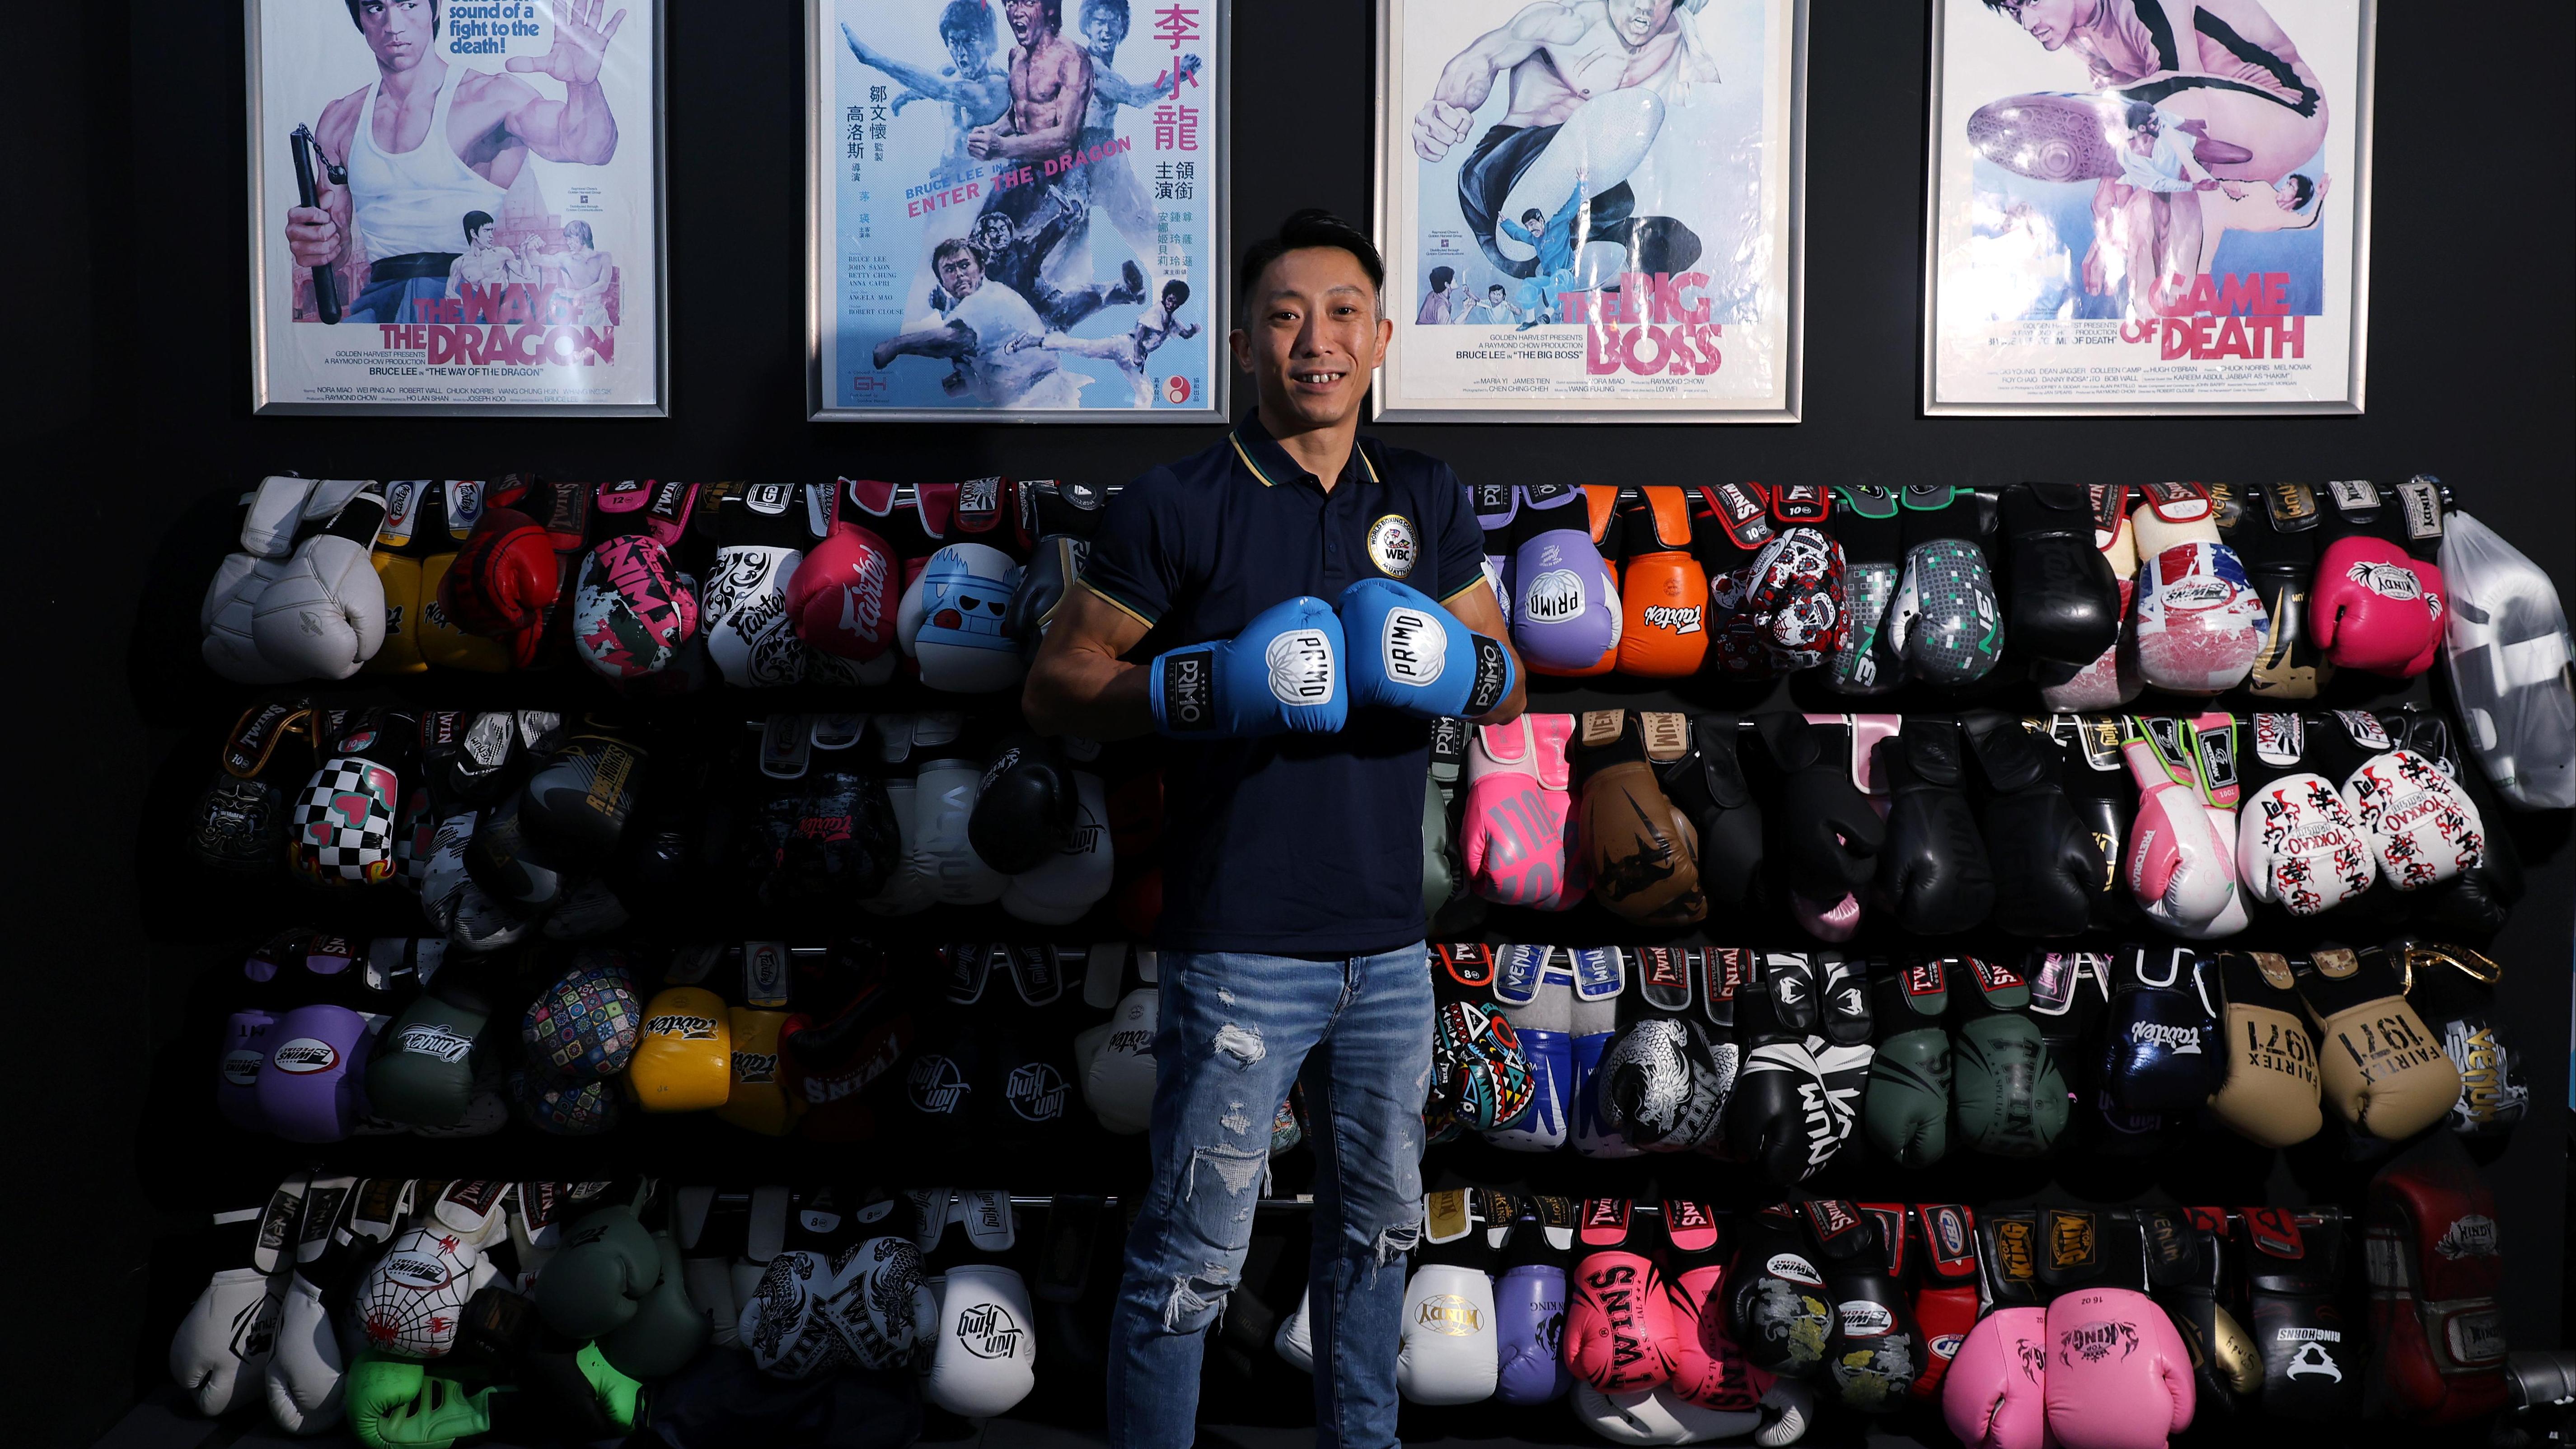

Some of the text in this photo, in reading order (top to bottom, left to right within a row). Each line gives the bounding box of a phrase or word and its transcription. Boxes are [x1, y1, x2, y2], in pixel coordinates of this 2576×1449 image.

[450, 3, 534, 19] sound of a
[450, 20, 539, 39] fight to the
[450, 37, 506, 54] death!
[1153, 4, 1199, 150] 李小龍
[847, 106, 864, 159] 高洛斯
[905, 167, 984, 199] BRUCE LEE
[908, 136, 1132, 218] ENTER THE DRAGON
[413, 283, 557, 324] THE WAY
[1557, 292, 1620, 324] THE
[1621, 272, 1710, 324] BIG
[2148, 273, 2291, 316] GAME
[379, 325, 614, 366] THE DRAGON
[1456, 351, 1552, 359] BRUCE LEE BIG
[1586, 324, 1722, 375] BOSS
[2120, 316, 2305, 360] OF DEATH
[370, 367, 399, 375] BRUCE
[401, 367, 417, 375] LEE
[389, 484, 412, 518] Fairtex
[459, 483, 474, 513] Fairtex
[1727, 482, 1760, 519] WINS
[2415, 488, 2435, 527] WINDY
[1371, 517, 1416, 549] WORLD BOXING COUNCIL
[1385, 549, 1410, 561] WBC
[838, 544, 889, 642] Fairtex
[1531, 591, 1578, 615] PRIMO
[2378, 576, 2413, 594] WINDY
[726, 587, 786, 646] Fairte
[1644, 605, 1702, 635] Fairtex
[1391, 615, 1423, 676] PRIMO
[1297, 637, 1326, 697] PRIMO
[1475, 644, 1497, 706] PRIMO
[1178, 660, 1200, 723] PRIMO
[240, 703, 287, 749] TWINS
[2385, 795, 2445, 832] YOKKAO
[2288, 828, 2348, 855] YOKKAO
[2133, 829, 2157, 892] PRETORIAN
[1650, 947, 1677, 982] TWIN
[644, 1015, 719, 1040] Fairtex
[2131, 1020, 2202, 1055] Fairtex
[2338, 1013, 2425, 1067] 1971
[731, 1050, 778, 1083] Fair
[2359, 1046, 2440, 1087] FAIRTEX
[2465, 1028, 2498, 1123] VENUM
[1034, 1083, 1073, 1119] Lion
[1672, 1059, 1722, 1146] WINS
[1823, 1200, 1854, 1231] WINS
[2457, 1224, 2492, 1239] WINDY
[826, 1271, 898, 1363] TWIN
[1419, 1304, 1480, 1331] WINDY
[2094, 1296, 2103, 1304] 16
[957, 1304, 1024, 1359] Lion King
[1584, 1265, 1657, 1389] TWINS
[2276, 1328, 2341, 1344] RINGHORNS
